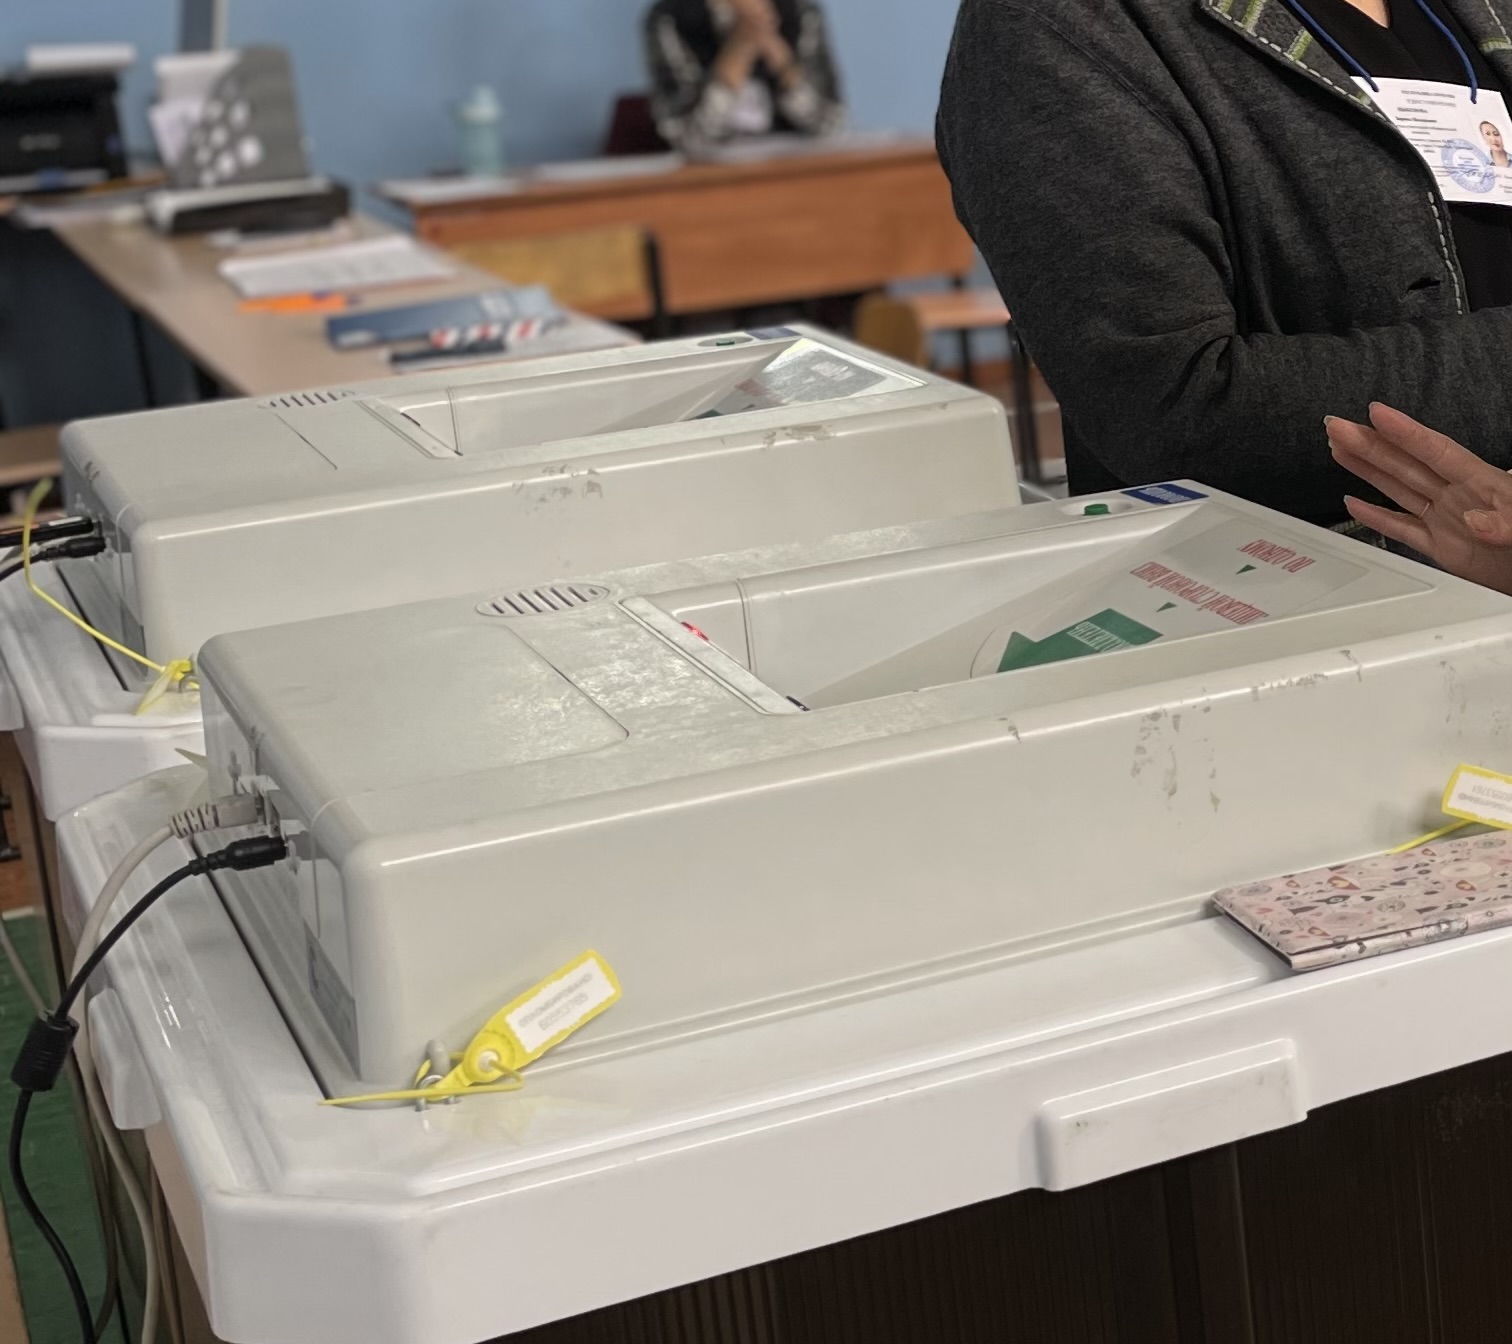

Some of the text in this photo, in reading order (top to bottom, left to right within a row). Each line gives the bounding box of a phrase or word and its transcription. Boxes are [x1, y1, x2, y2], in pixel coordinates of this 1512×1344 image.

[1237, 539, 1316, 573] ПО ОДНОМУ
[1148, 571, 1220, 604] СТОРОНОЙ
[1197, 594, 1269, 625] ЛИЦЕВОЙ
